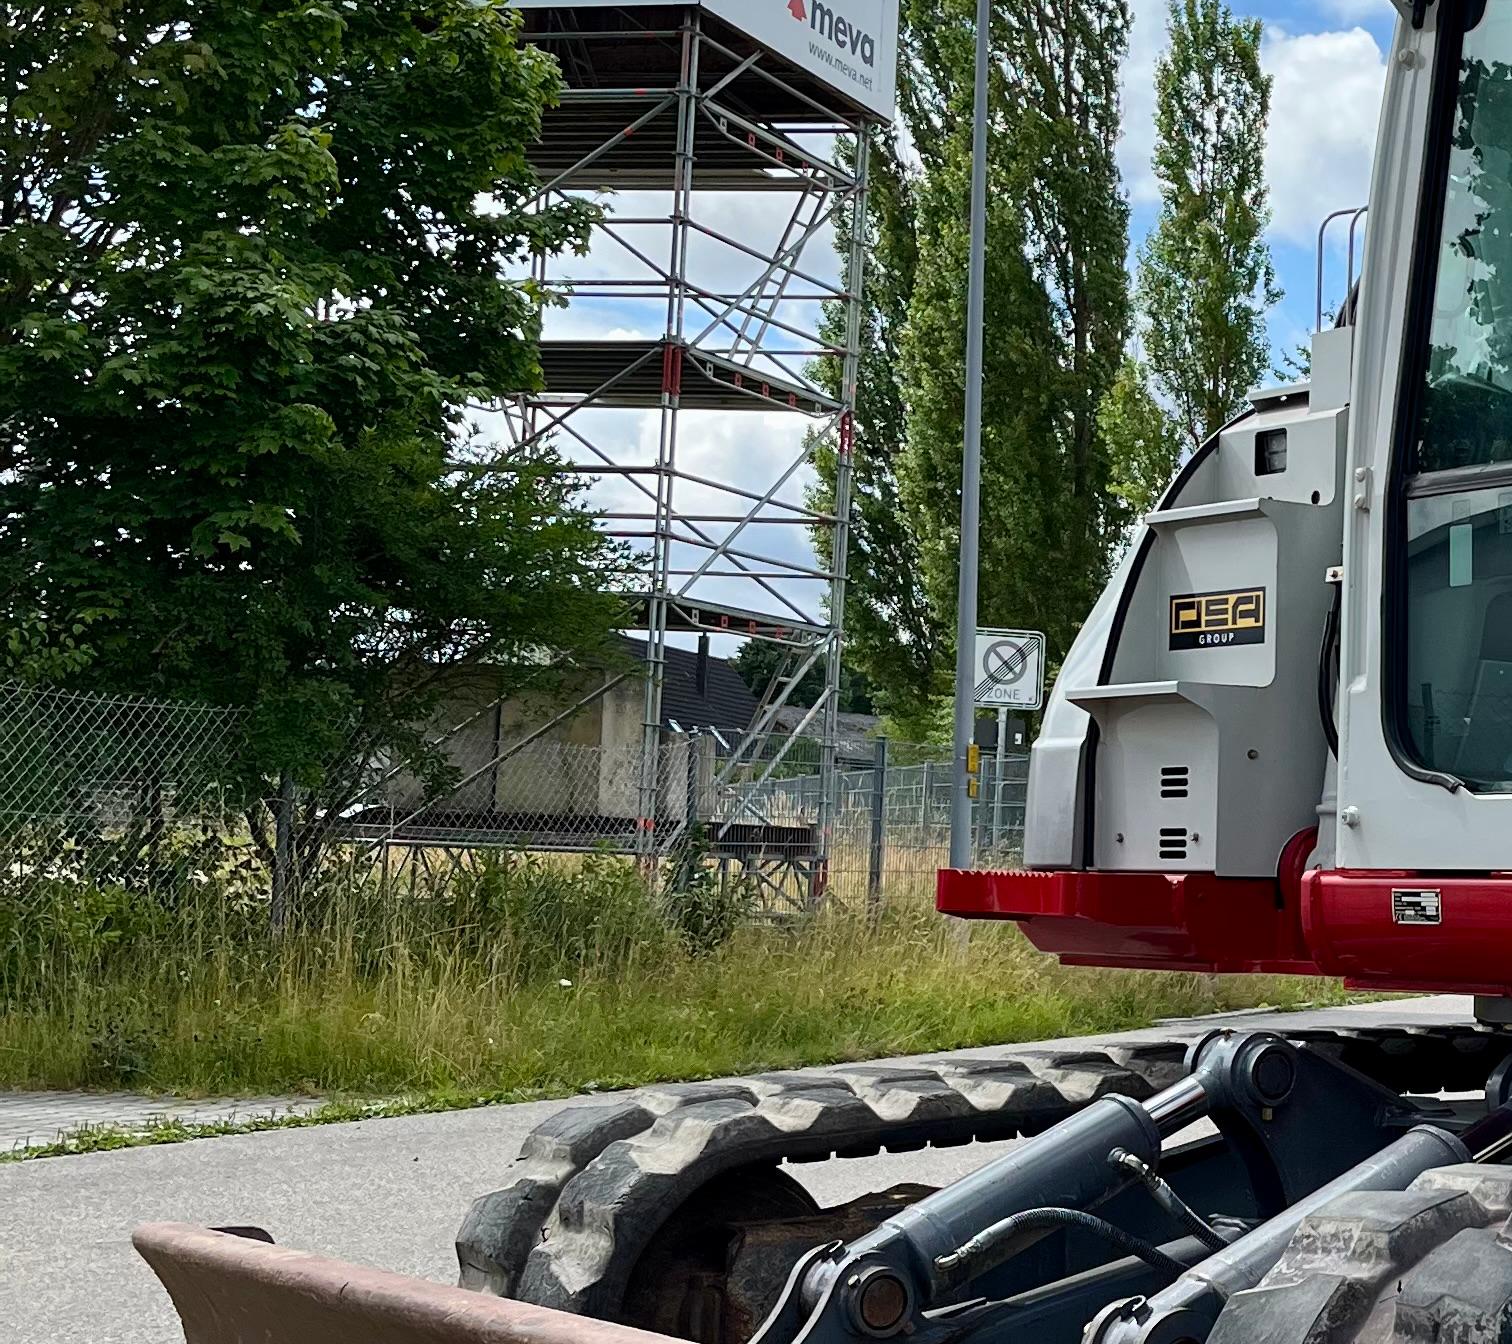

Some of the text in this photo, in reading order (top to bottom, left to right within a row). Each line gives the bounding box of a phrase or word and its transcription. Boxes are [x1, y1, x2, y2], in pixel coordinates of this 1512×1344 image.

[808, 41, 873, 92] www.meva.net
[1198, 632, 1235, 645] GROUP
[986, 687, 1022, 701] ZONE
